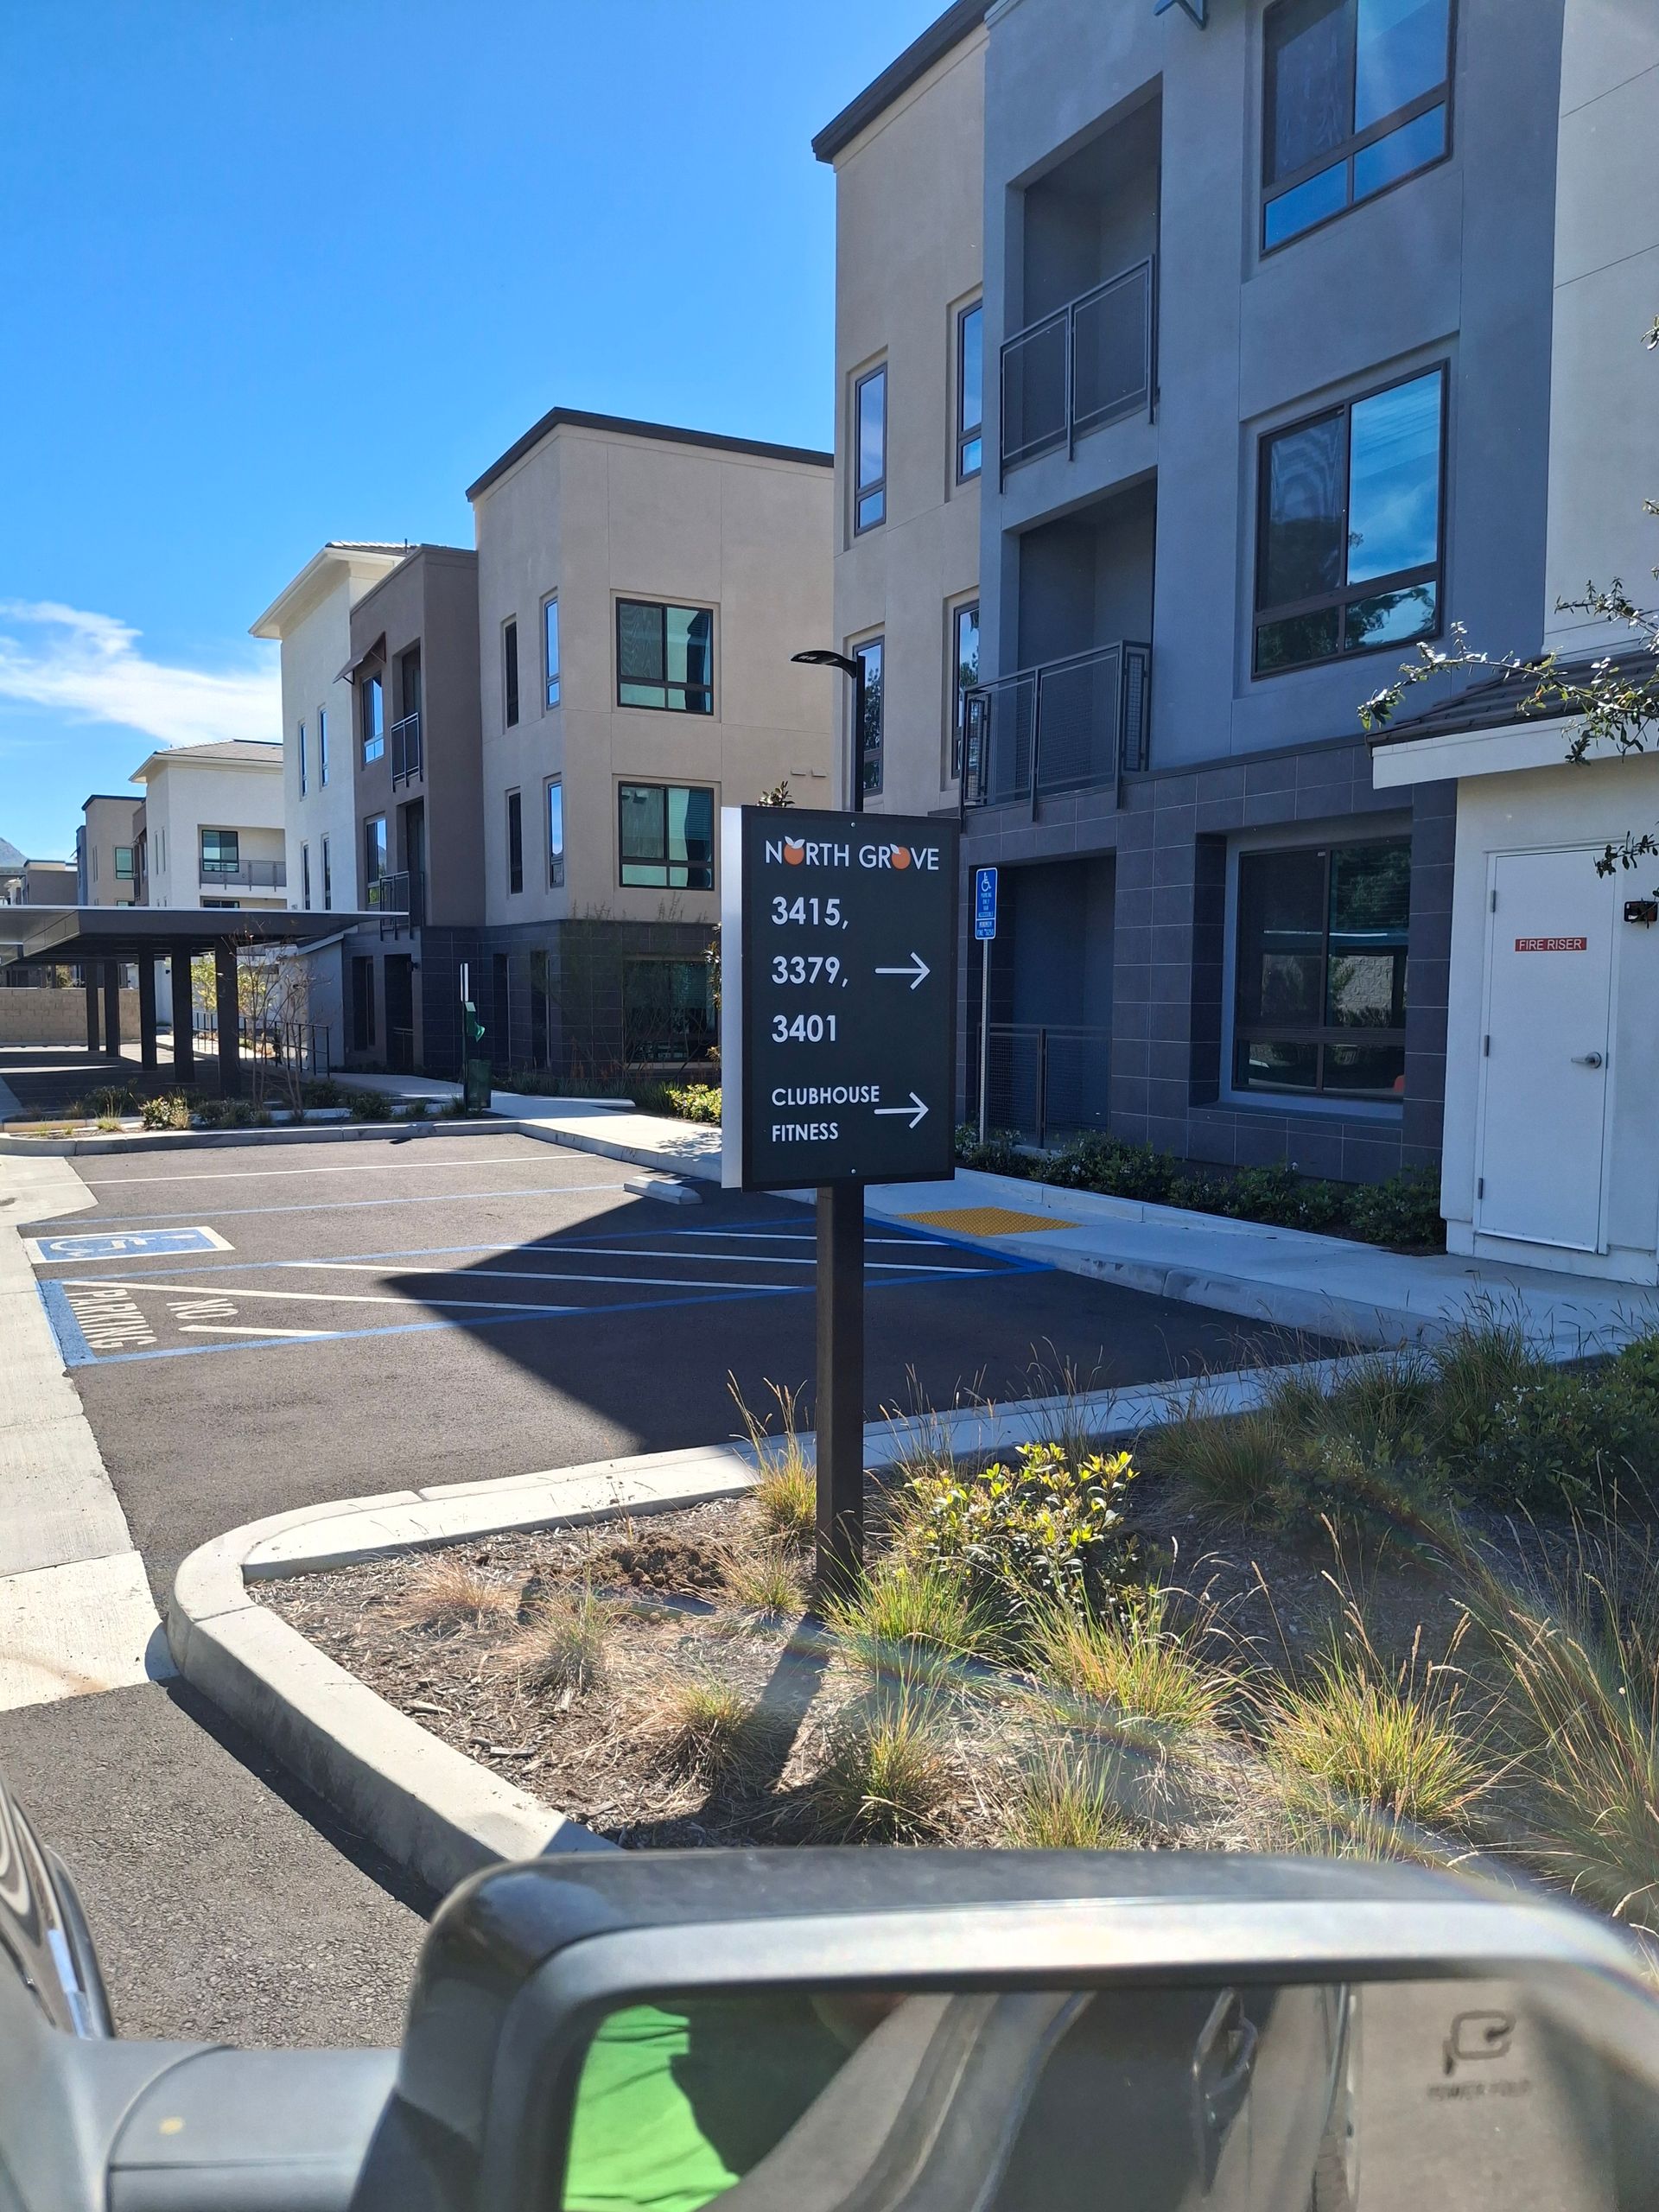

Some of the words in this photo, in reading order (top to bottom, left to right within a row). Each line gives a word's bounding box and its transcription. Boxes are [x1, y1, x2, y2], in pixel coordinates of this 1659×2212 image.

[766, 836, 849, 867] NORTH
[859, 844, 939, 870] GROVE
[772, 896, 849, 930] 3415,
[1519, 939, 1544, 950] FIRE
[1547, 938, 1582, 950] RISER
[772, 956, 849, 988] 3379,
[772, 1014, 836, 1043] 3401
[772, 1085, 880, 1106] CLUBHOUSE
[772, 1122, 839, 1142] FITNESS
[65, 1288, 158, 1349] PARKING
[166, 1298, 239, 1319] NO
